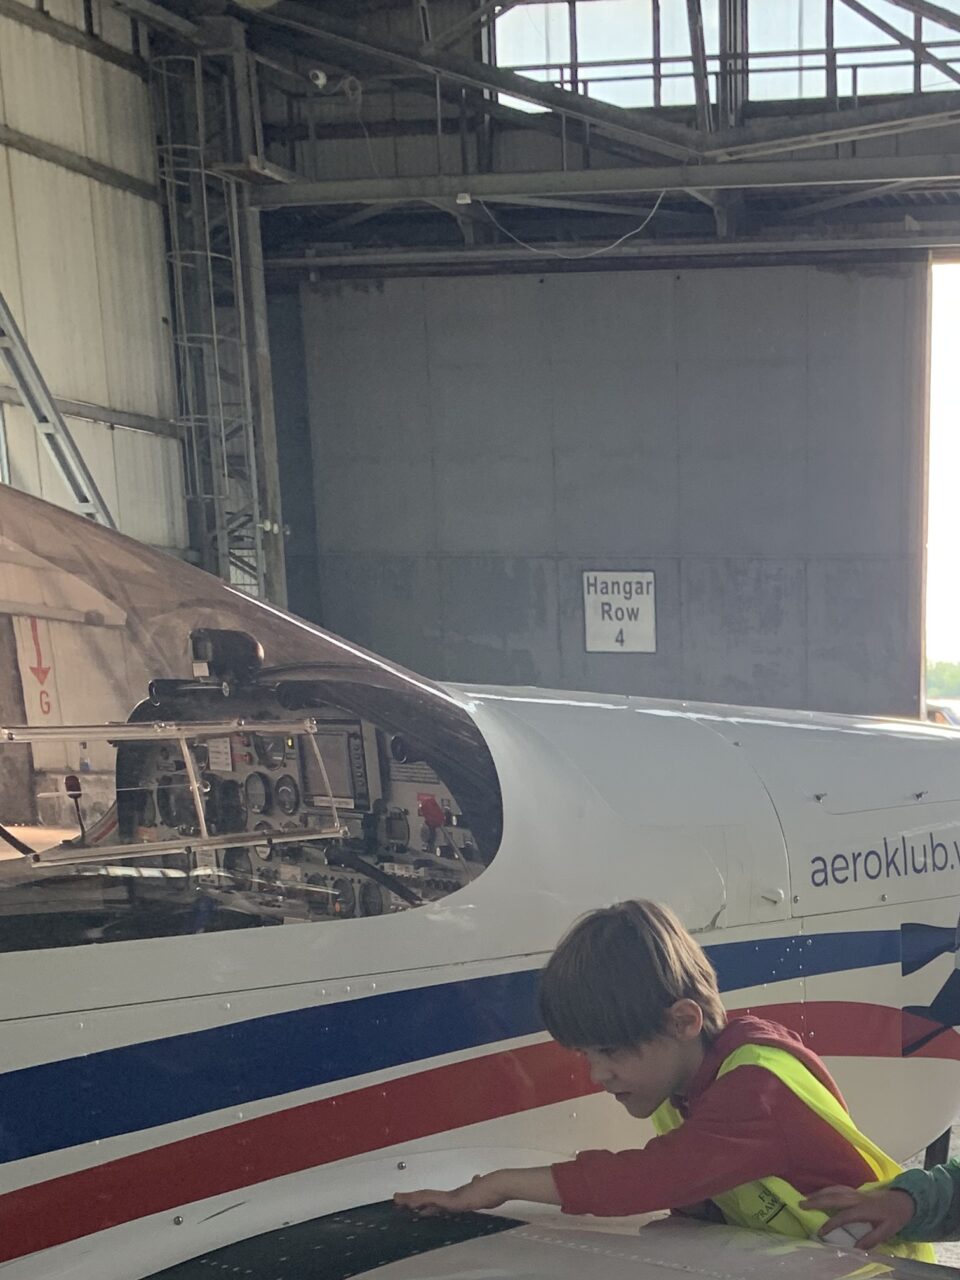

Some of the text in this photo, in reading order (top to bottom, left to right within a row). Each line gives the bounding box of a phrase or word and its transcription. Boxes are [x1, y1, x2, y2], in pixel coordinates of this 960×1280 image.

[586, 575, 653, 600] Hangar
[600, 602, 640, 621] Row
[614, 628, 625, 647] 4
[39, 690, 50, 715] G
